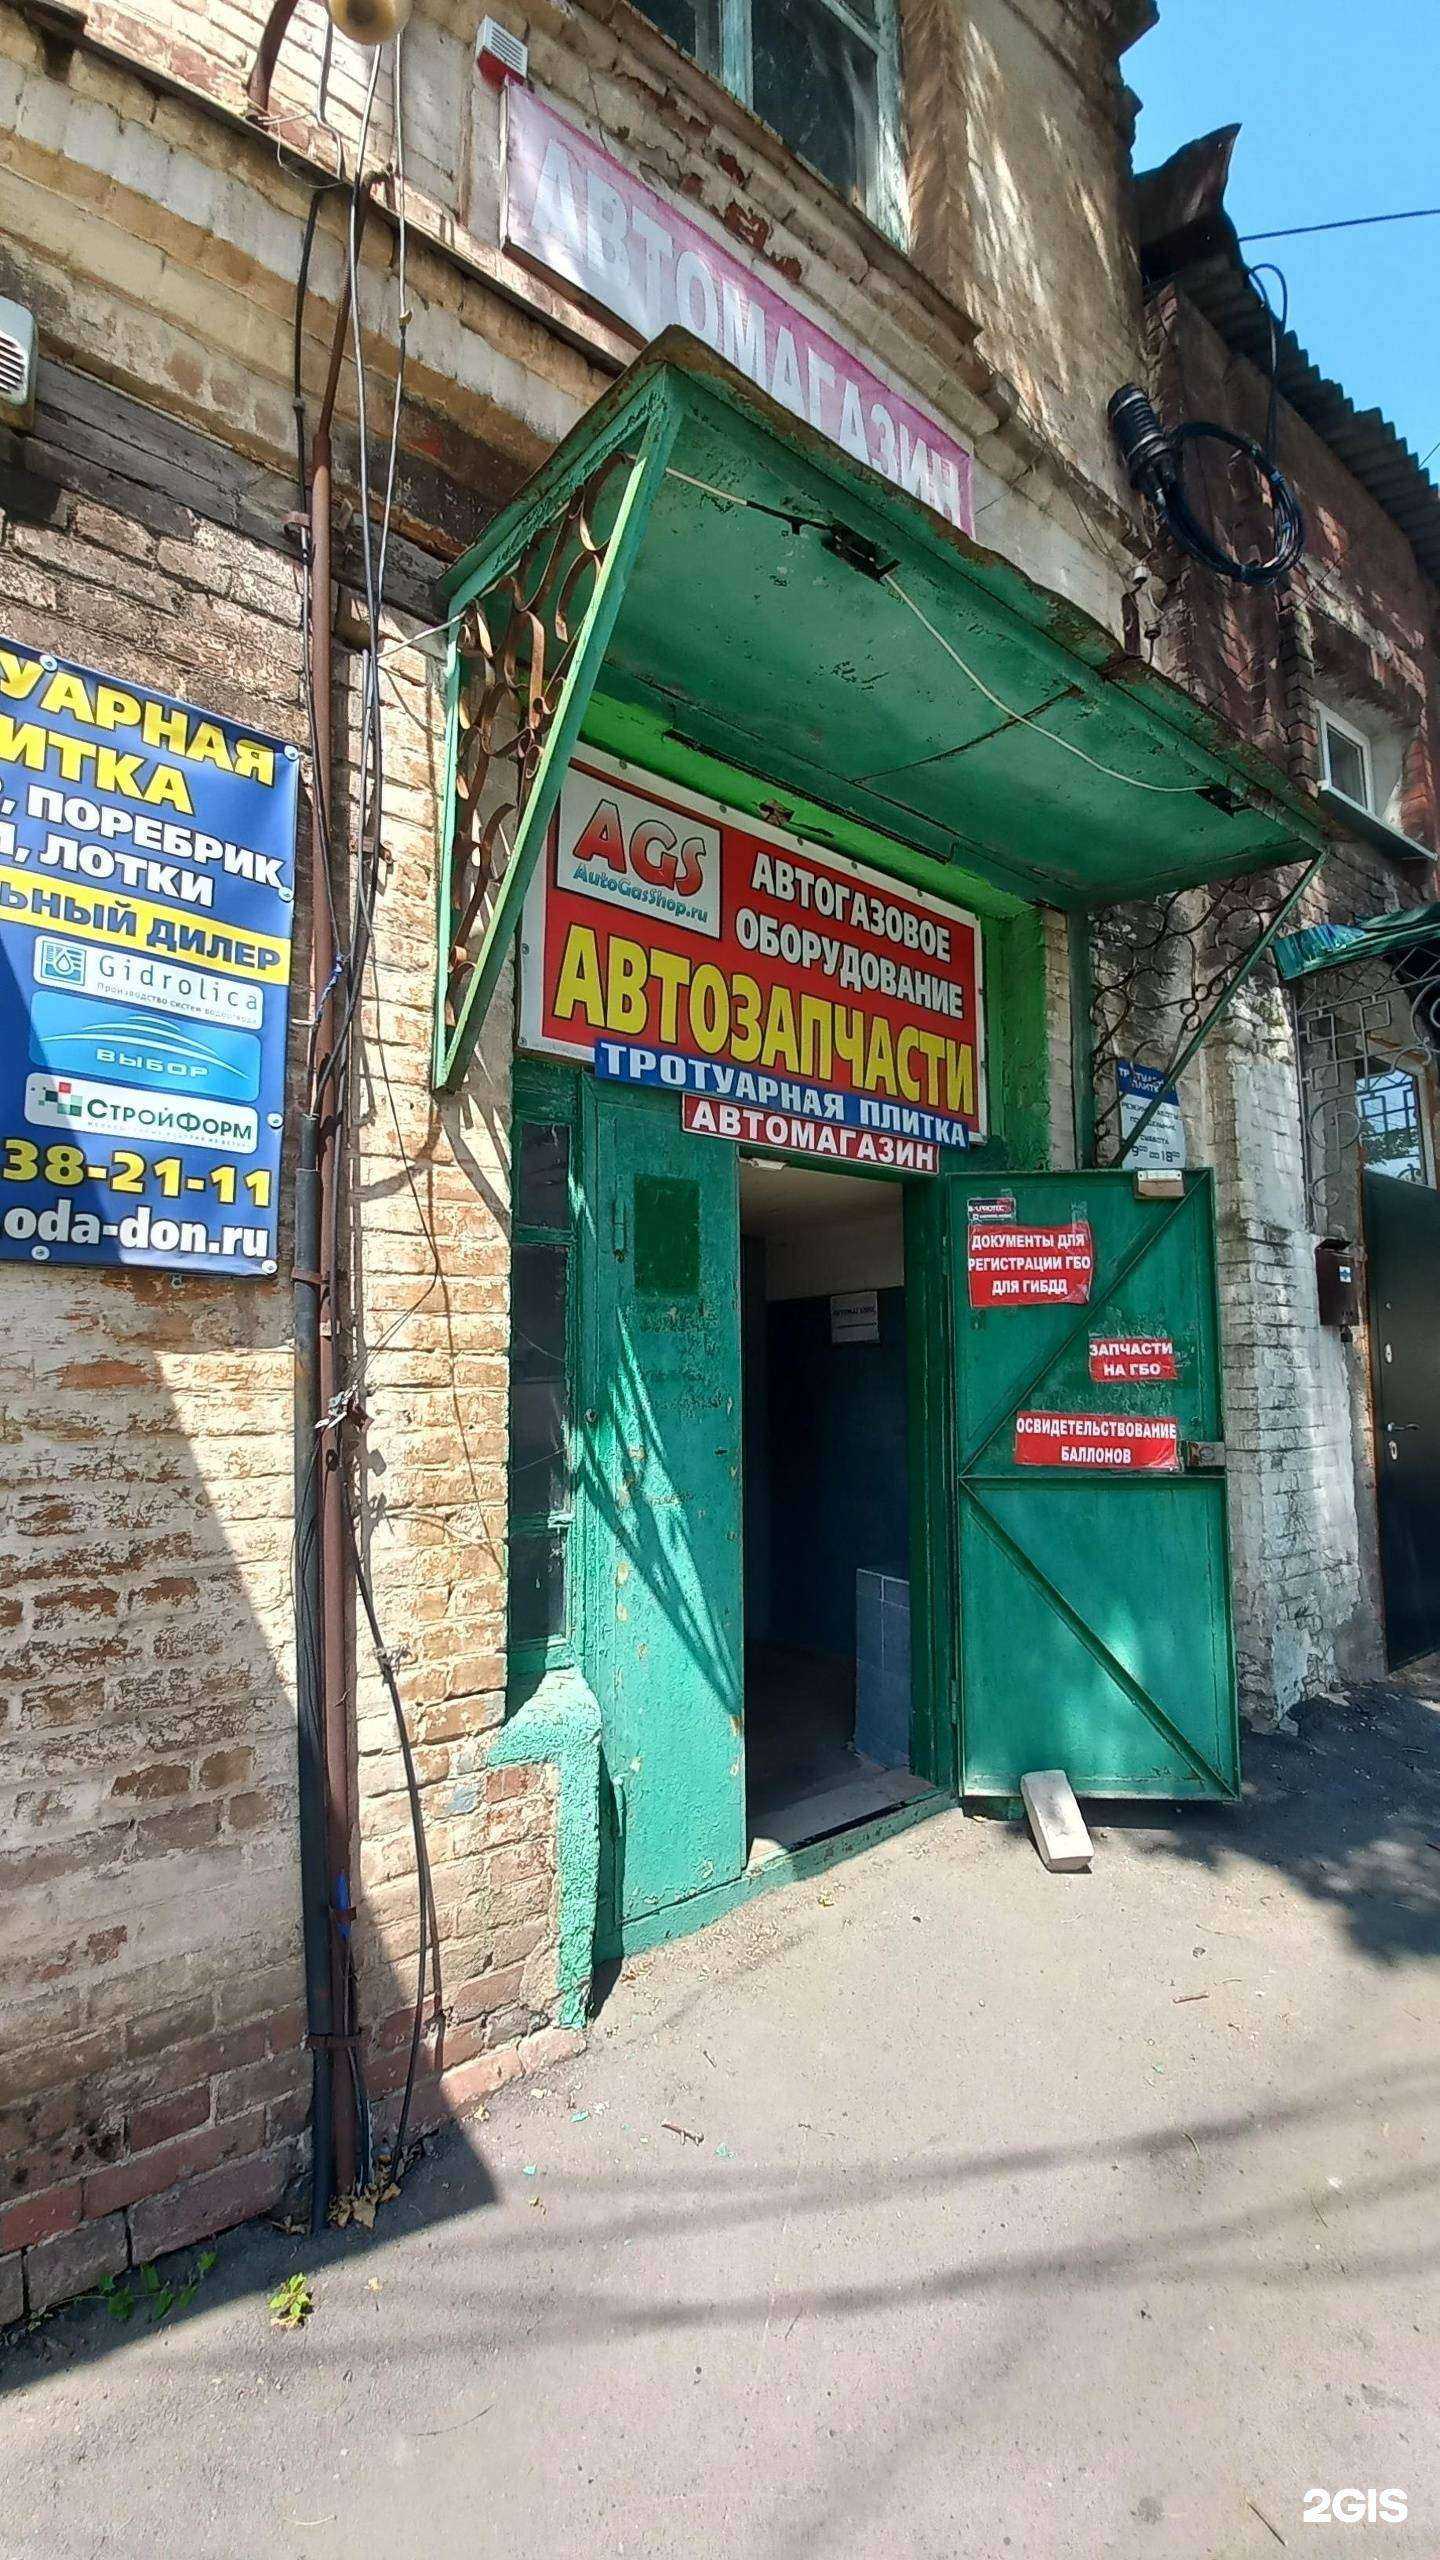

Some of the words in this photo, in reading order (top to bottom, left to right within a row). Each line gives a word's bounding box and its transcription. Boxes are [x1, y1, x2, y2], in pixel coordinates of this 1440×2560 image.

[530, 138, 961, 527] АВТОМАГАЗИН
[0, 650, 275, 787] УАРНАЯ
[27, 784, 284, 889] ПОРЕБРИК
[573, 799, 706, 897] AGS
[39, 832, 215, 907] ЛОТКИ
[573, 863, 708, 923] AutoGasShop.ru
[751, 852, 951, 964] АВТОГАЗОВОЕ
[146, 917, 281, 971] ДИЛЕР
[736, 908, 963, 1019] ОБОРУДОВАНИЕ
[98, 954, 258, 1010] Gidrolica
[553, 922, 976, 1116] АВТОЗАПЧАСТИ
[96, 1048, 208, 1078] ВЫБОР
[601, 1042, 844, 1121] ТРОТУАРНАЯ
[859, 1099, 967, 1148] ПЛИТКА
[691, 1101, 935, 1171] АВТОМАГАЗИН
[3, 1138, 271, 1207] 38-21-11
[968, 1256, 1062, 1272] РЕГИСТРАЦИИ
[1065, 1256, 1091, 1270] ГБО
[971, 1233, 1053, 1250] ДОКУМЕНТЫ
[1058, 1233, 1085, 1249] ДЛЯ
[992, 1280, 1019, 1296] ДЛЯ
[1023, 1278, 1068, 1295] ГИБДД
[1089, 1342, 1173, 1356] ЗАПЧАСТИ
[1104, 1364, 1126, 1376] НА
[1130, 1363, 1161, 1376] ГБО
[1016, 1417, 1177, 1439] ОСВИДЕТЕЛЬСТВОВАНИЕ
[1061, 1446, 1131, 1464] БАЛЛОНОВ
